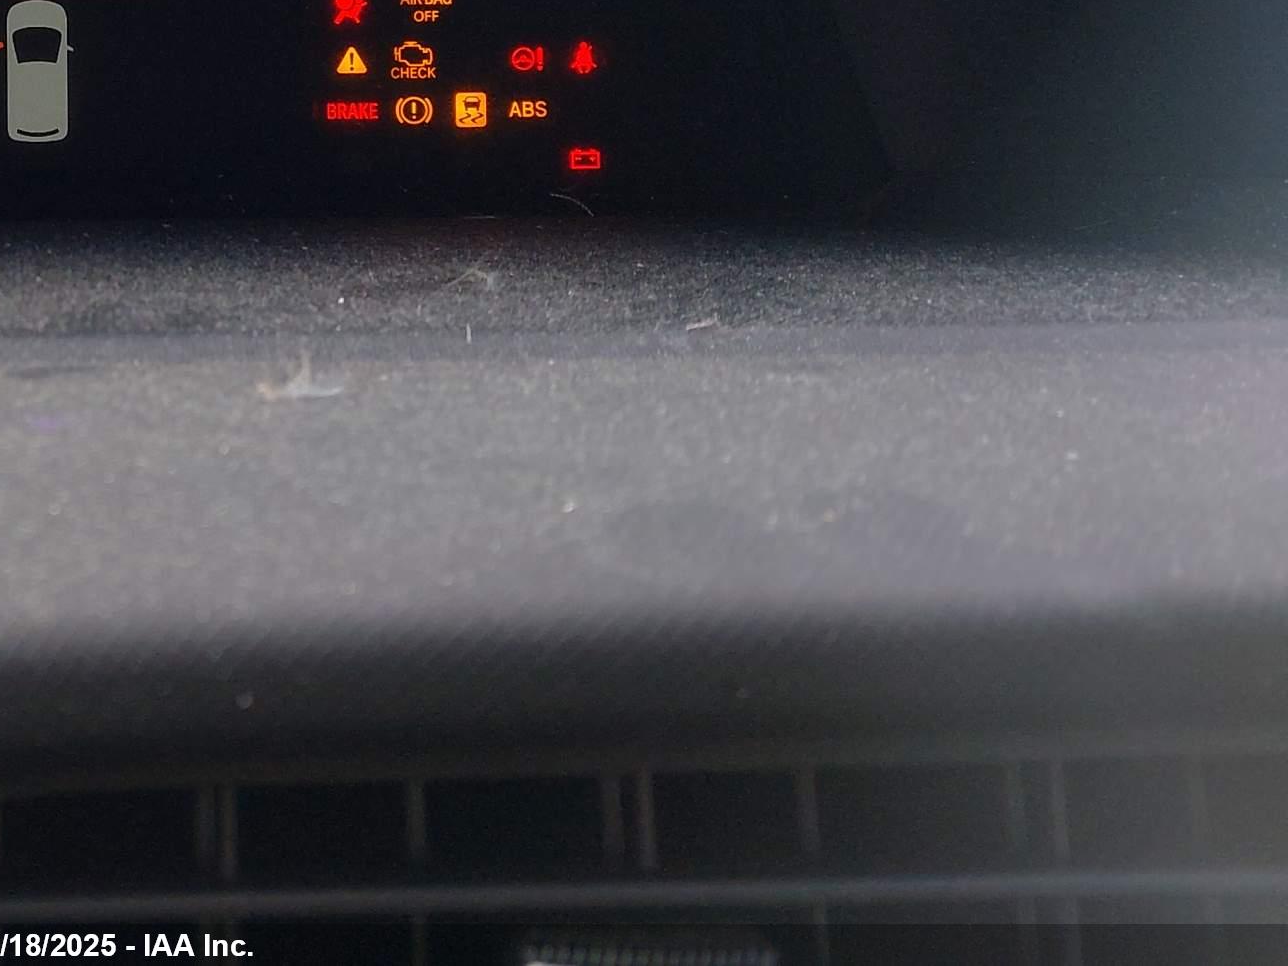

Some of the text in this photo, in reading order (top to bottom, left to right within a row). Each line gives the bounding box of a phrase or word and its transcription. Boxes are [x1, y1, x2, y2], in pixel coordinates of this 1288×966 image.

[413, 10, 440, 22] OFF
[390, 66, 436, 79] CHECK
[326, 102, 380, 121] BRAKE
[508, 101, 548, 118] ABS
